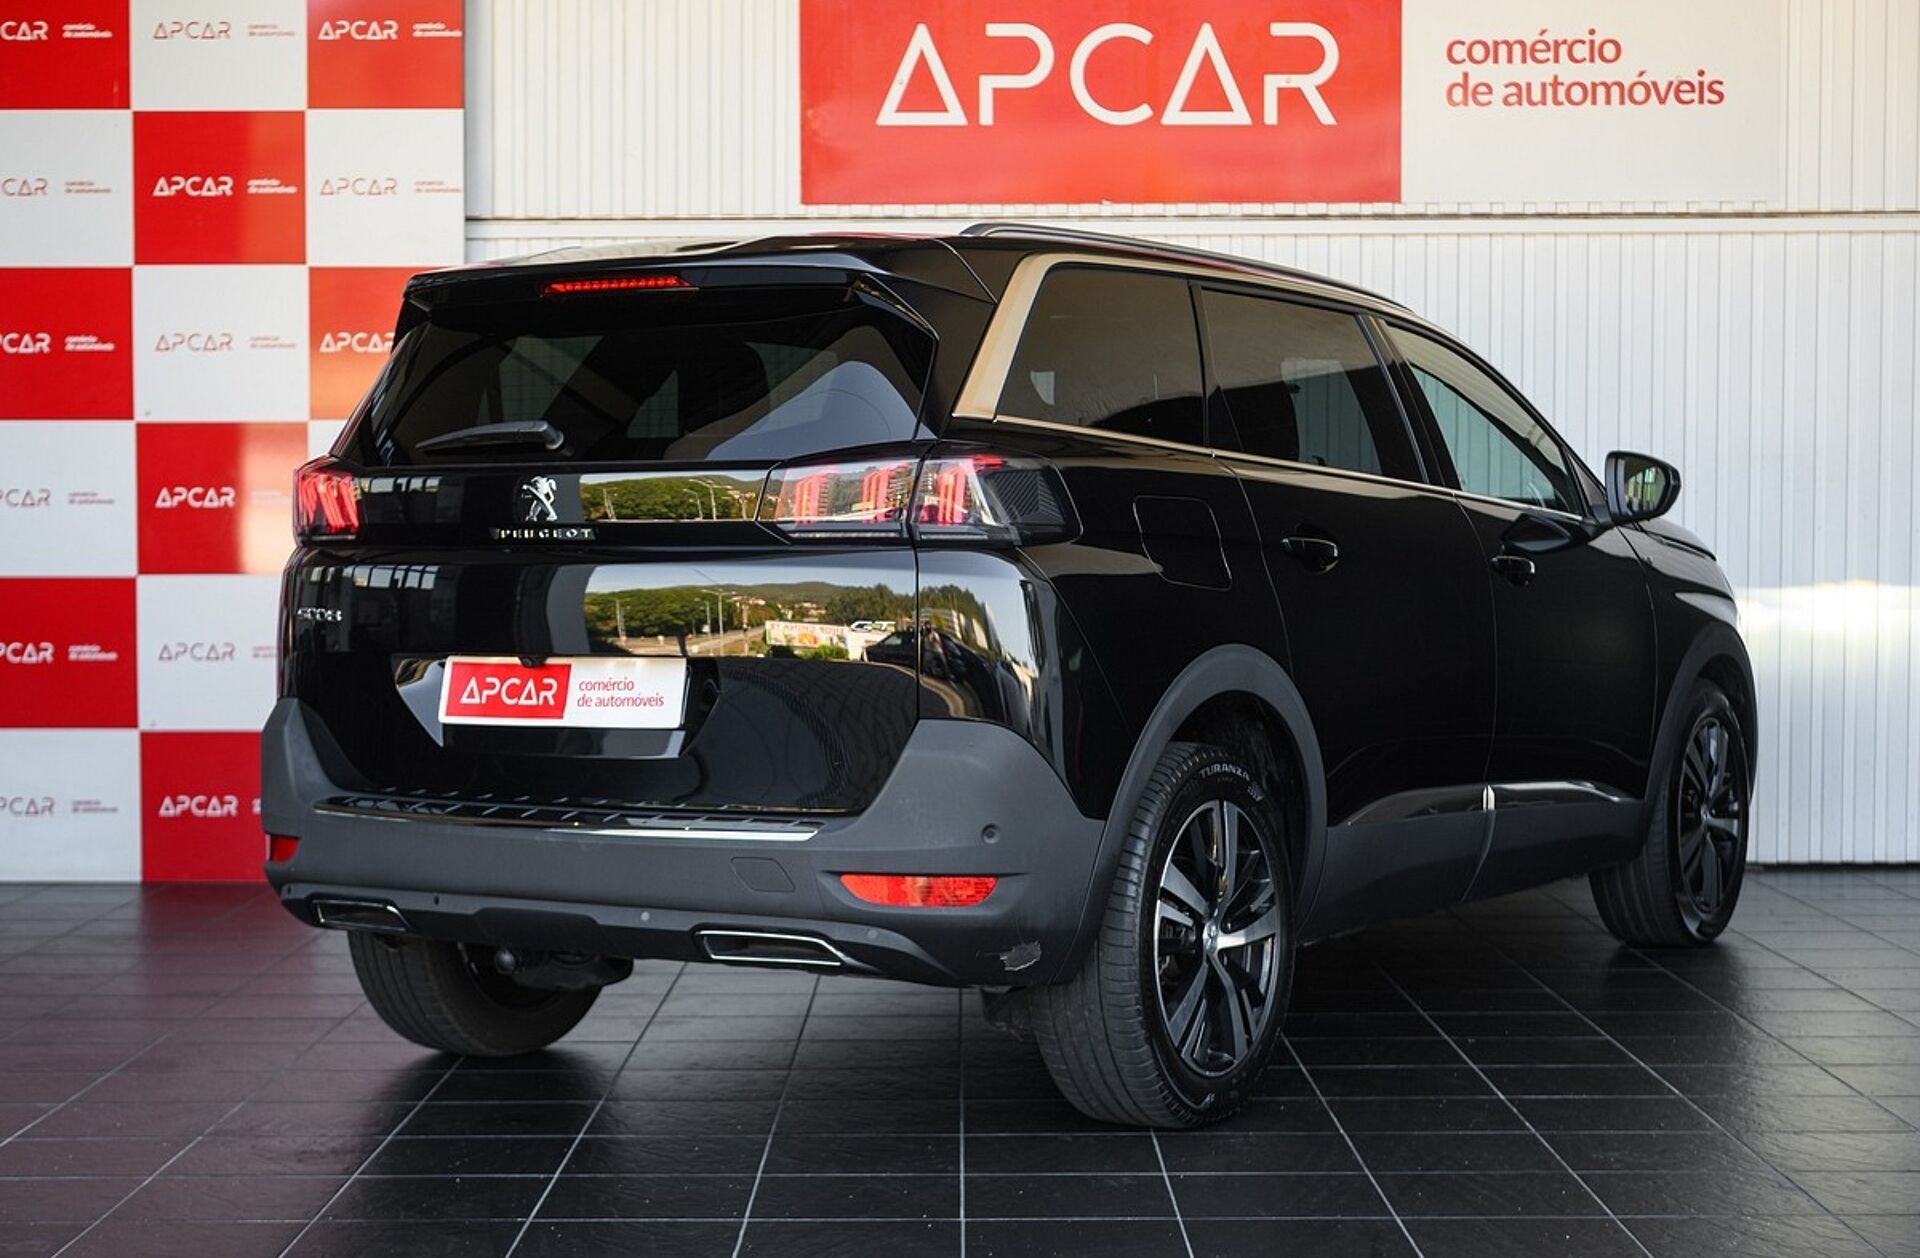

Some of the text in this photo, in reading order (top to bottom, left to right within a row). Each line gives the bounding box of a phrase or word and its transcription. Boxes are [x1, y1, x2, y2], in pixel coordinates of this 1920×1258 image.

[152, 21, 231, 39] APCAR
[318, 20, 398, 40] APCAR
[1446, 28, 1623, 65] comércio
[876, 22, 1340, 127] APCAR
[1446, 69, 1726, 107] de automóveis
[152, 176, 233, 196] APCAR
[319, 177, 398, 196] APCAR
[0, 332, 51, 354] CAR
[155, 332, 233, 351] APCAR
[0, 488, 51, 508] CAR
[155, 486, 236, 508] APCAR
[500, 528, 592, 540] PEUGEOT
[850, 620, 897, 633] GT
[158, 641, 236, 661] APCAR
[459, 676, 559, 707] APCAR
[578, 676, 635, 693] comércio
[577, 692, 665, 708] de automóveis
[1200, 763, 1250, 781] TURANZA
[158, 794, 239, 818] APCAR
